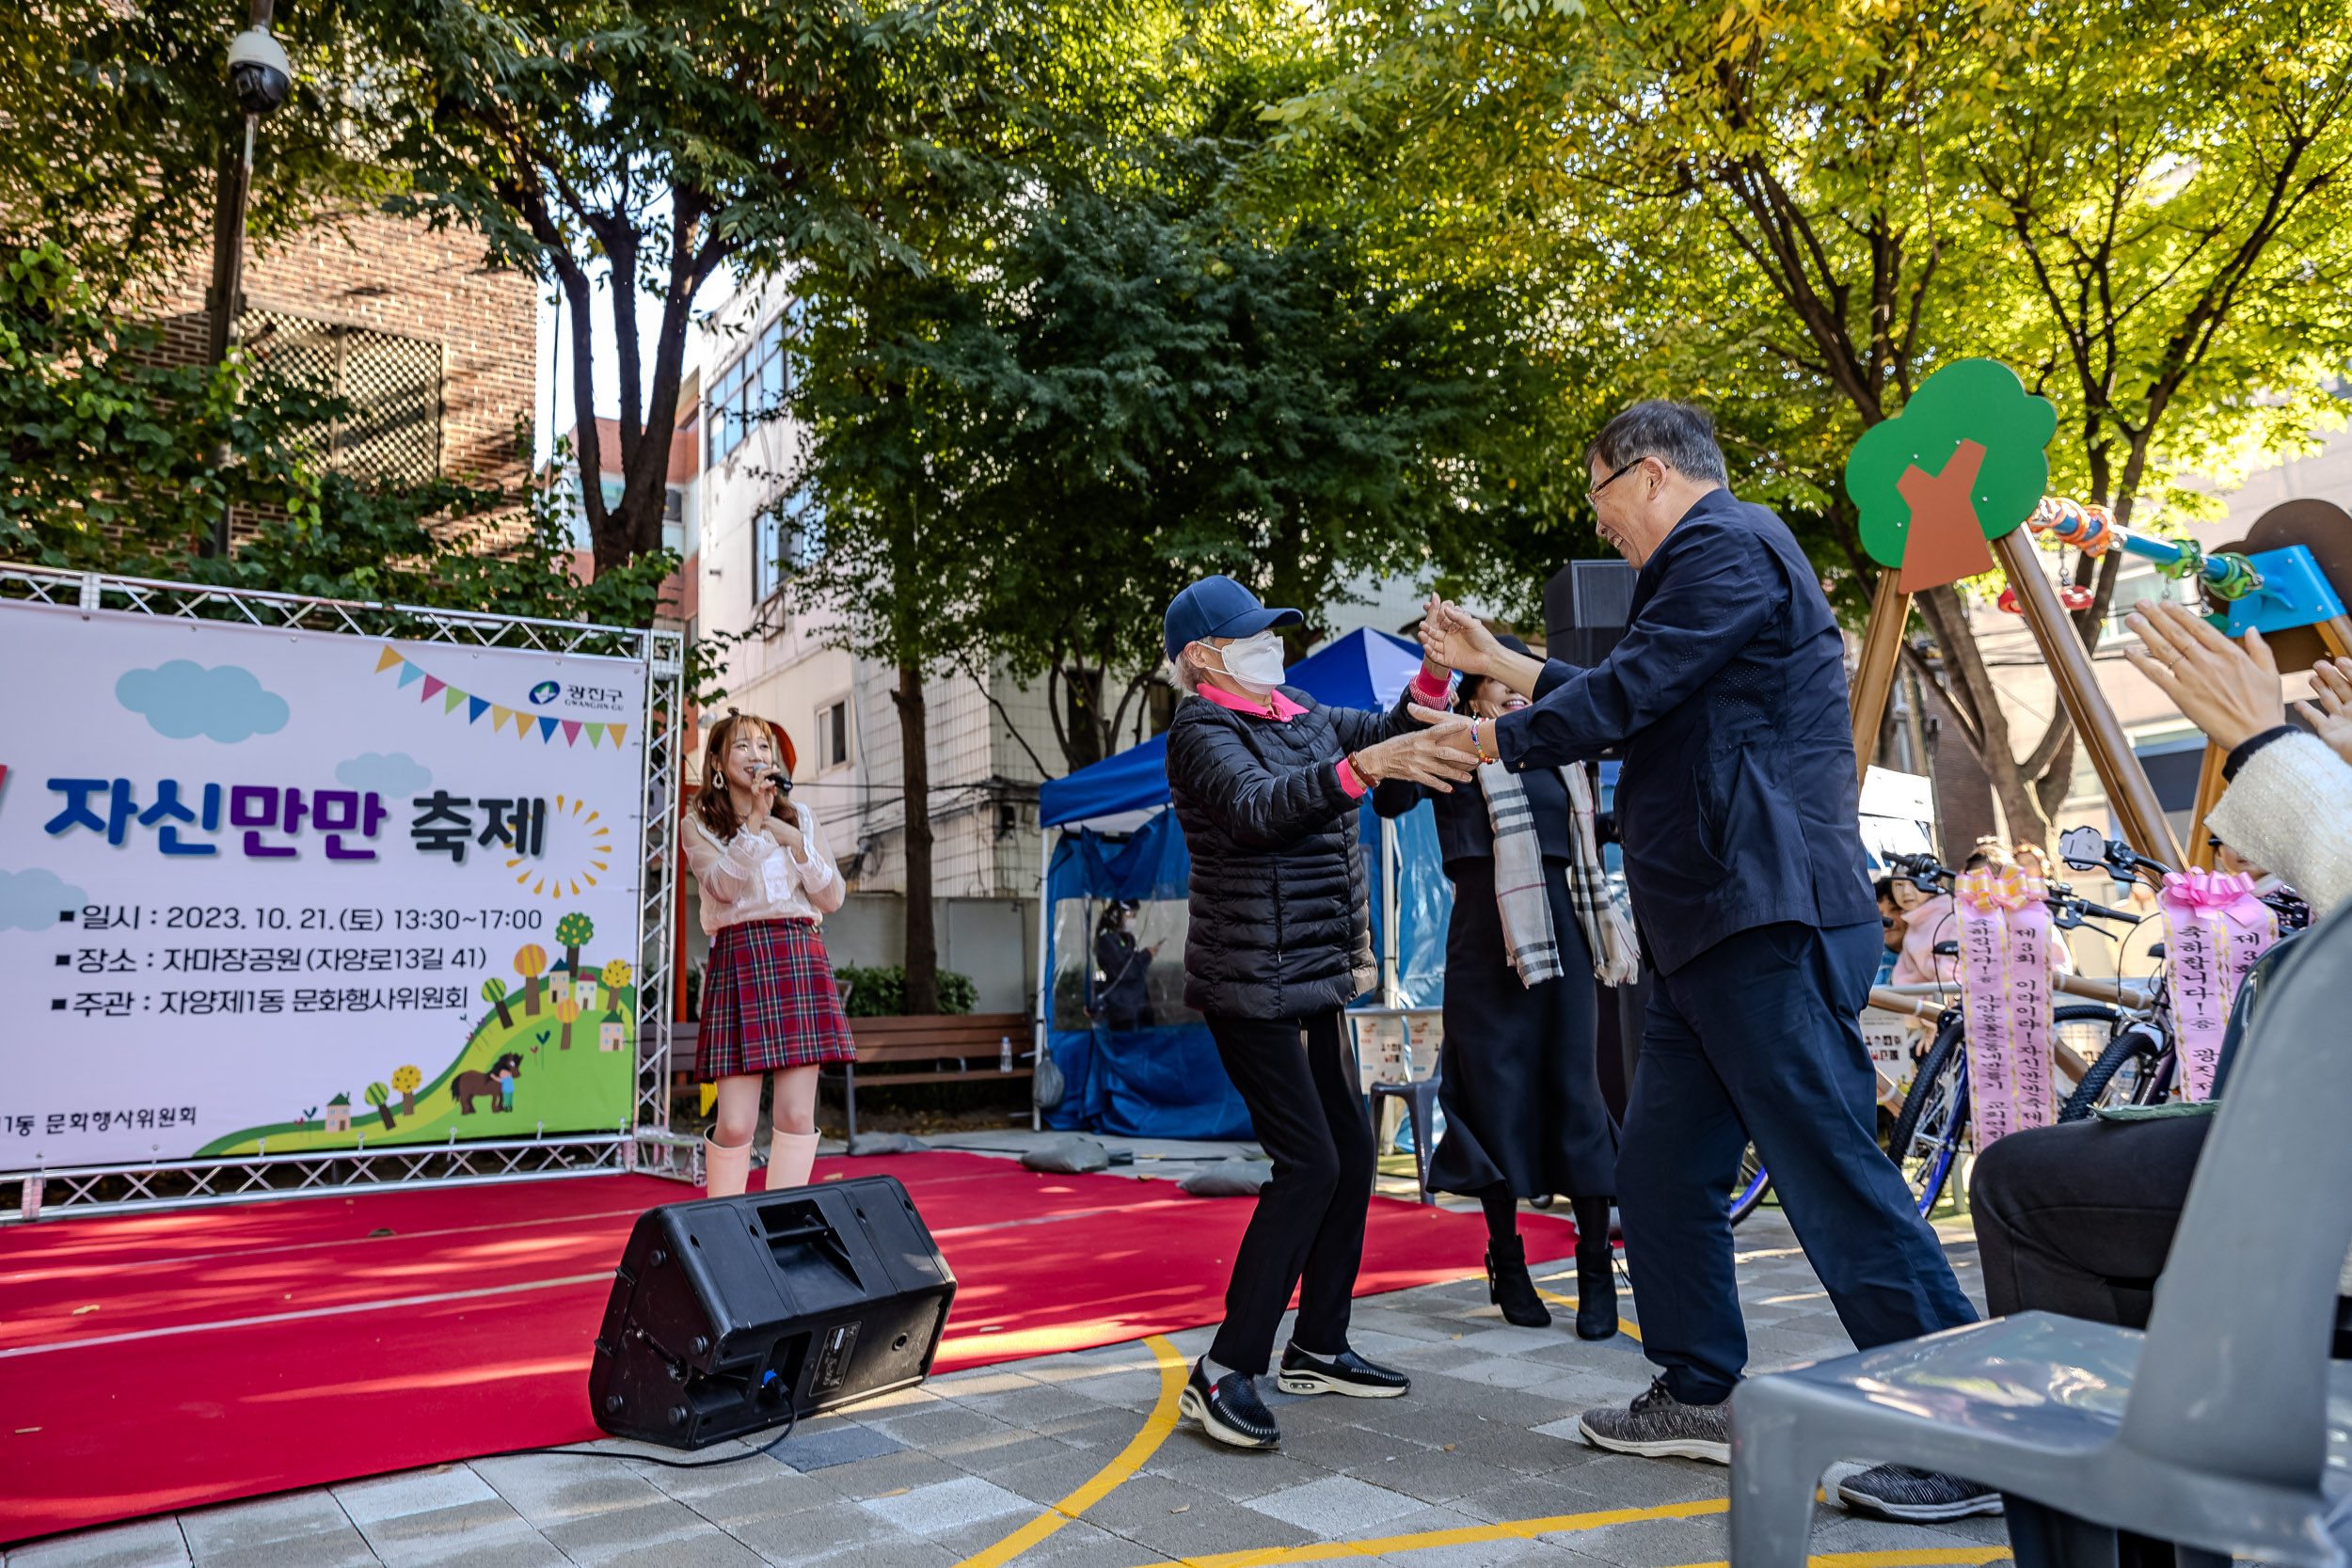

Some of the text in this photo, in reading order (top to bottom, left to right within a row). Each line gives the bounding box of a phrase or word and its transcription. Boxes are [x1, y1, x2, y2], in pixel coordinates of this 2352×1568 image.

[566, 685, 623, 703] 광진구
[44, 778, 389, 862] 자신만만
[410, 789, 548, 863] 축제
[82, 905, 140, 930] 일시
[167, 906, 246, 930] 2023.
[256, 908, 292, 930] 10.
[300, 908, 384, 931] 21.(토)
[394, 909, 542, 930] 13:30~17:00
[77, 948, 137, 974] 장소
[451, 947, 487, 970] 41)
[2014, 927, 2037, 966] 제3회
[72, 991, 135, 1018] 주관
[159, 990, 285, 1015] 자양제1동
[293, 986, 468, 1013] 문화행사위원회
[0, 1106, 197, 1137] 1동 문화행사위원회
